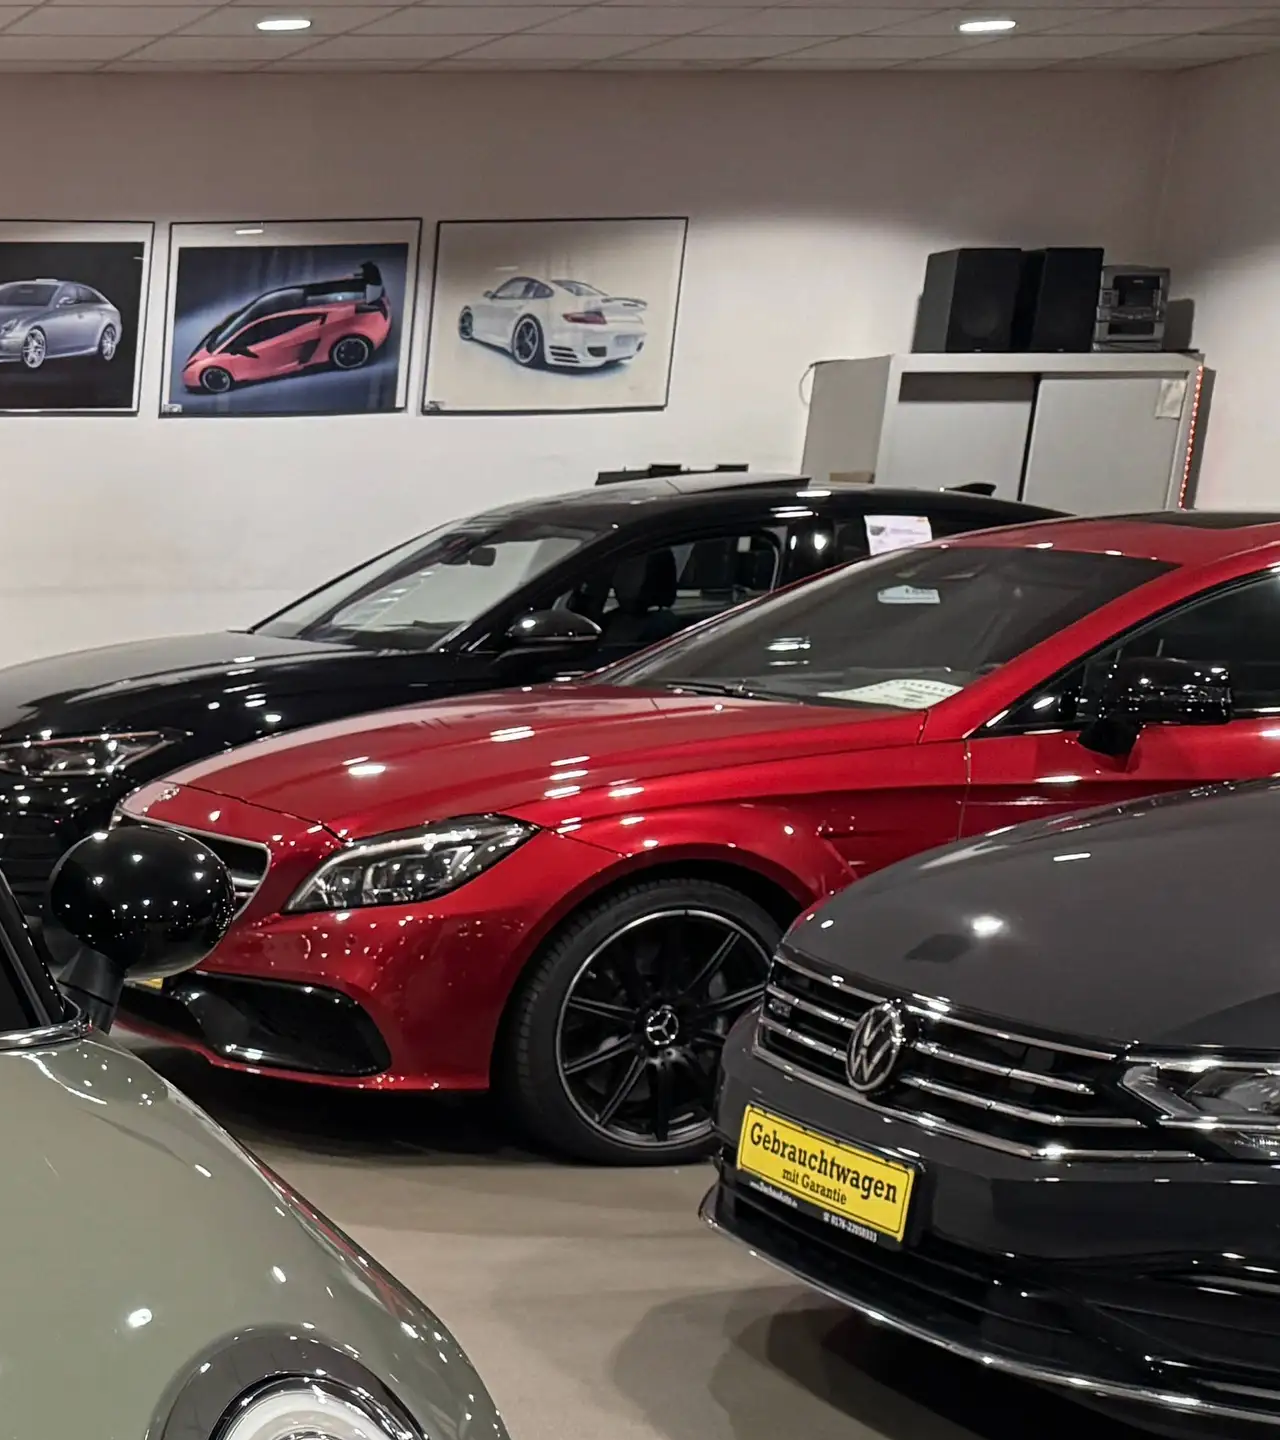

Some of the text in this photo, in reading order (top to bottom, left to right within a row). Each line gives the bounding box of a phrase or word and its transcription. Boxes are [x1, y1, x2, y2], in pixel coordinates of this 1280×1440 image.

[750, 1122, 897, 1204] Gebrauchtwagen
[782, 1168, 847, 1205] mit Garantie
